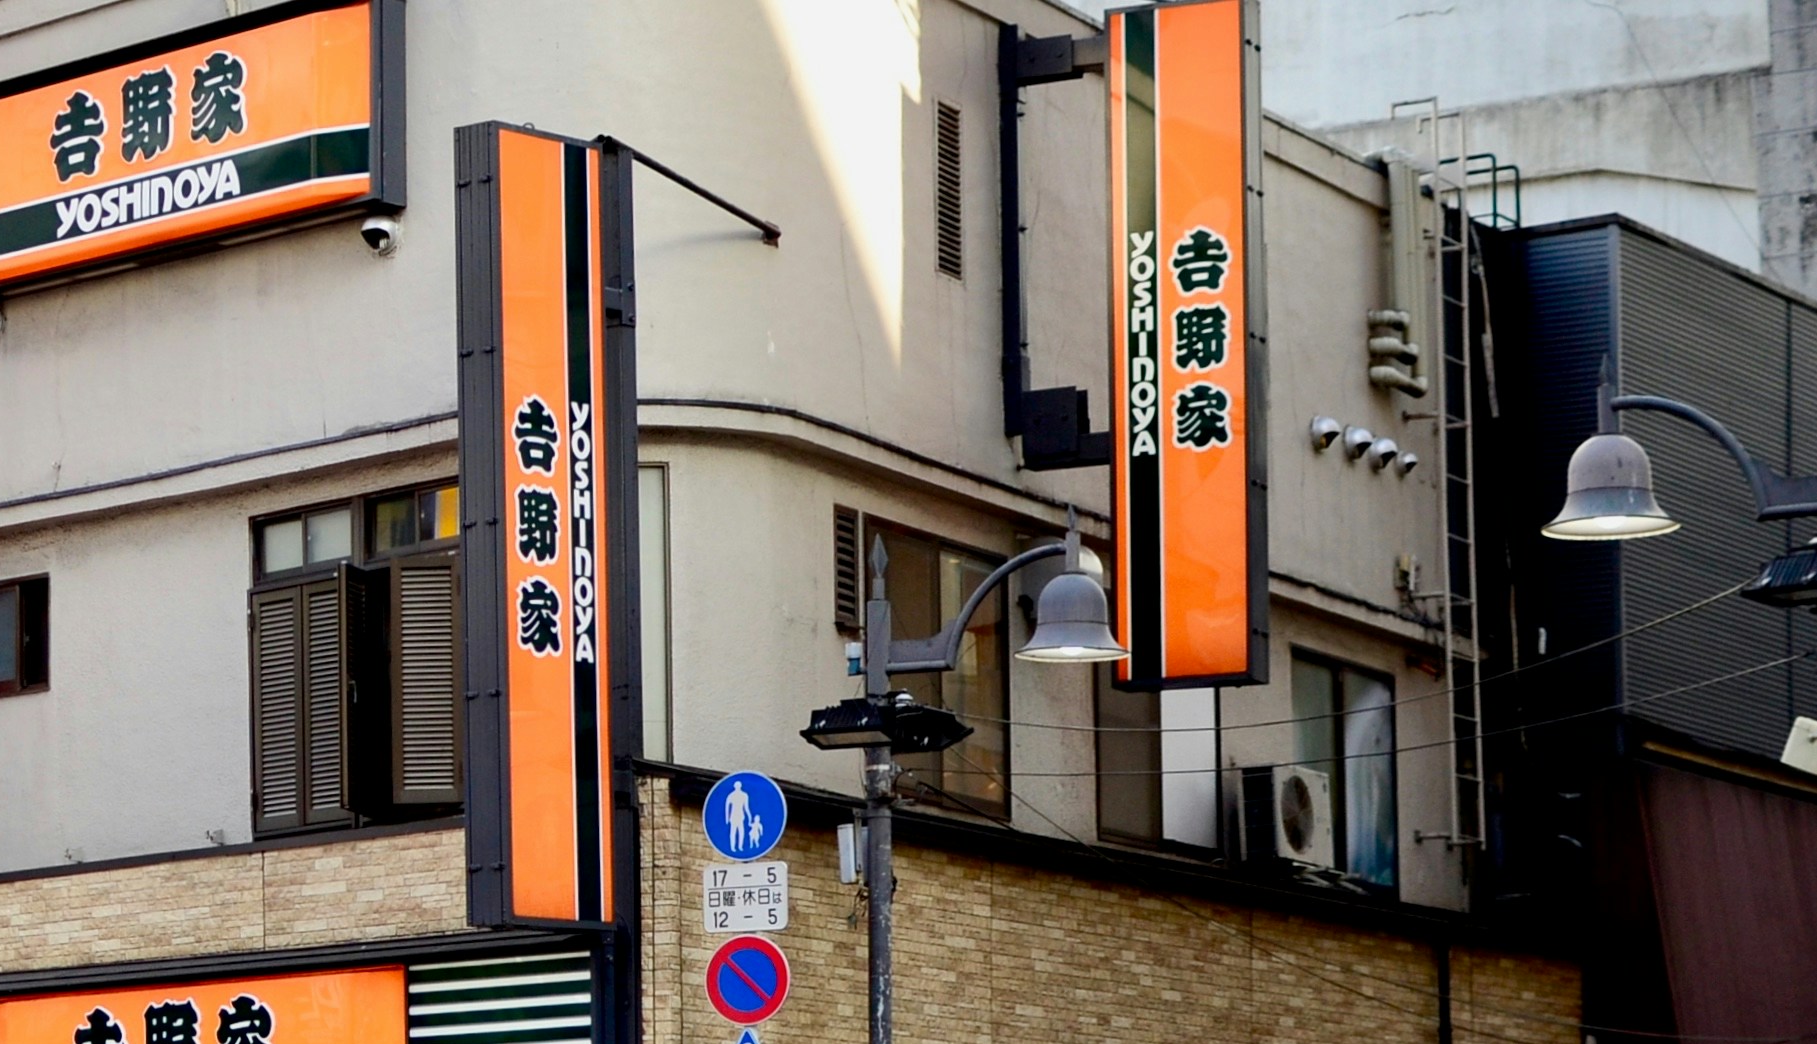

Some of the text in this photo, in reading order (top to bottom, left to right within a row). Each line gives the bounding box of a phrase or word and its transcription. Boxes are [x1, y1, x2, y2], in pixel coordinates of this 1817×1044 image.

[55, 158, 241, 239] YOSHINOYA
[1129, 231, 1157, 456] YOSHINOYA
[570, 402, 595, 665] YOSHINOYA
[712, 869, 727, 887] 17
[713, 911, 729, 929] 12
